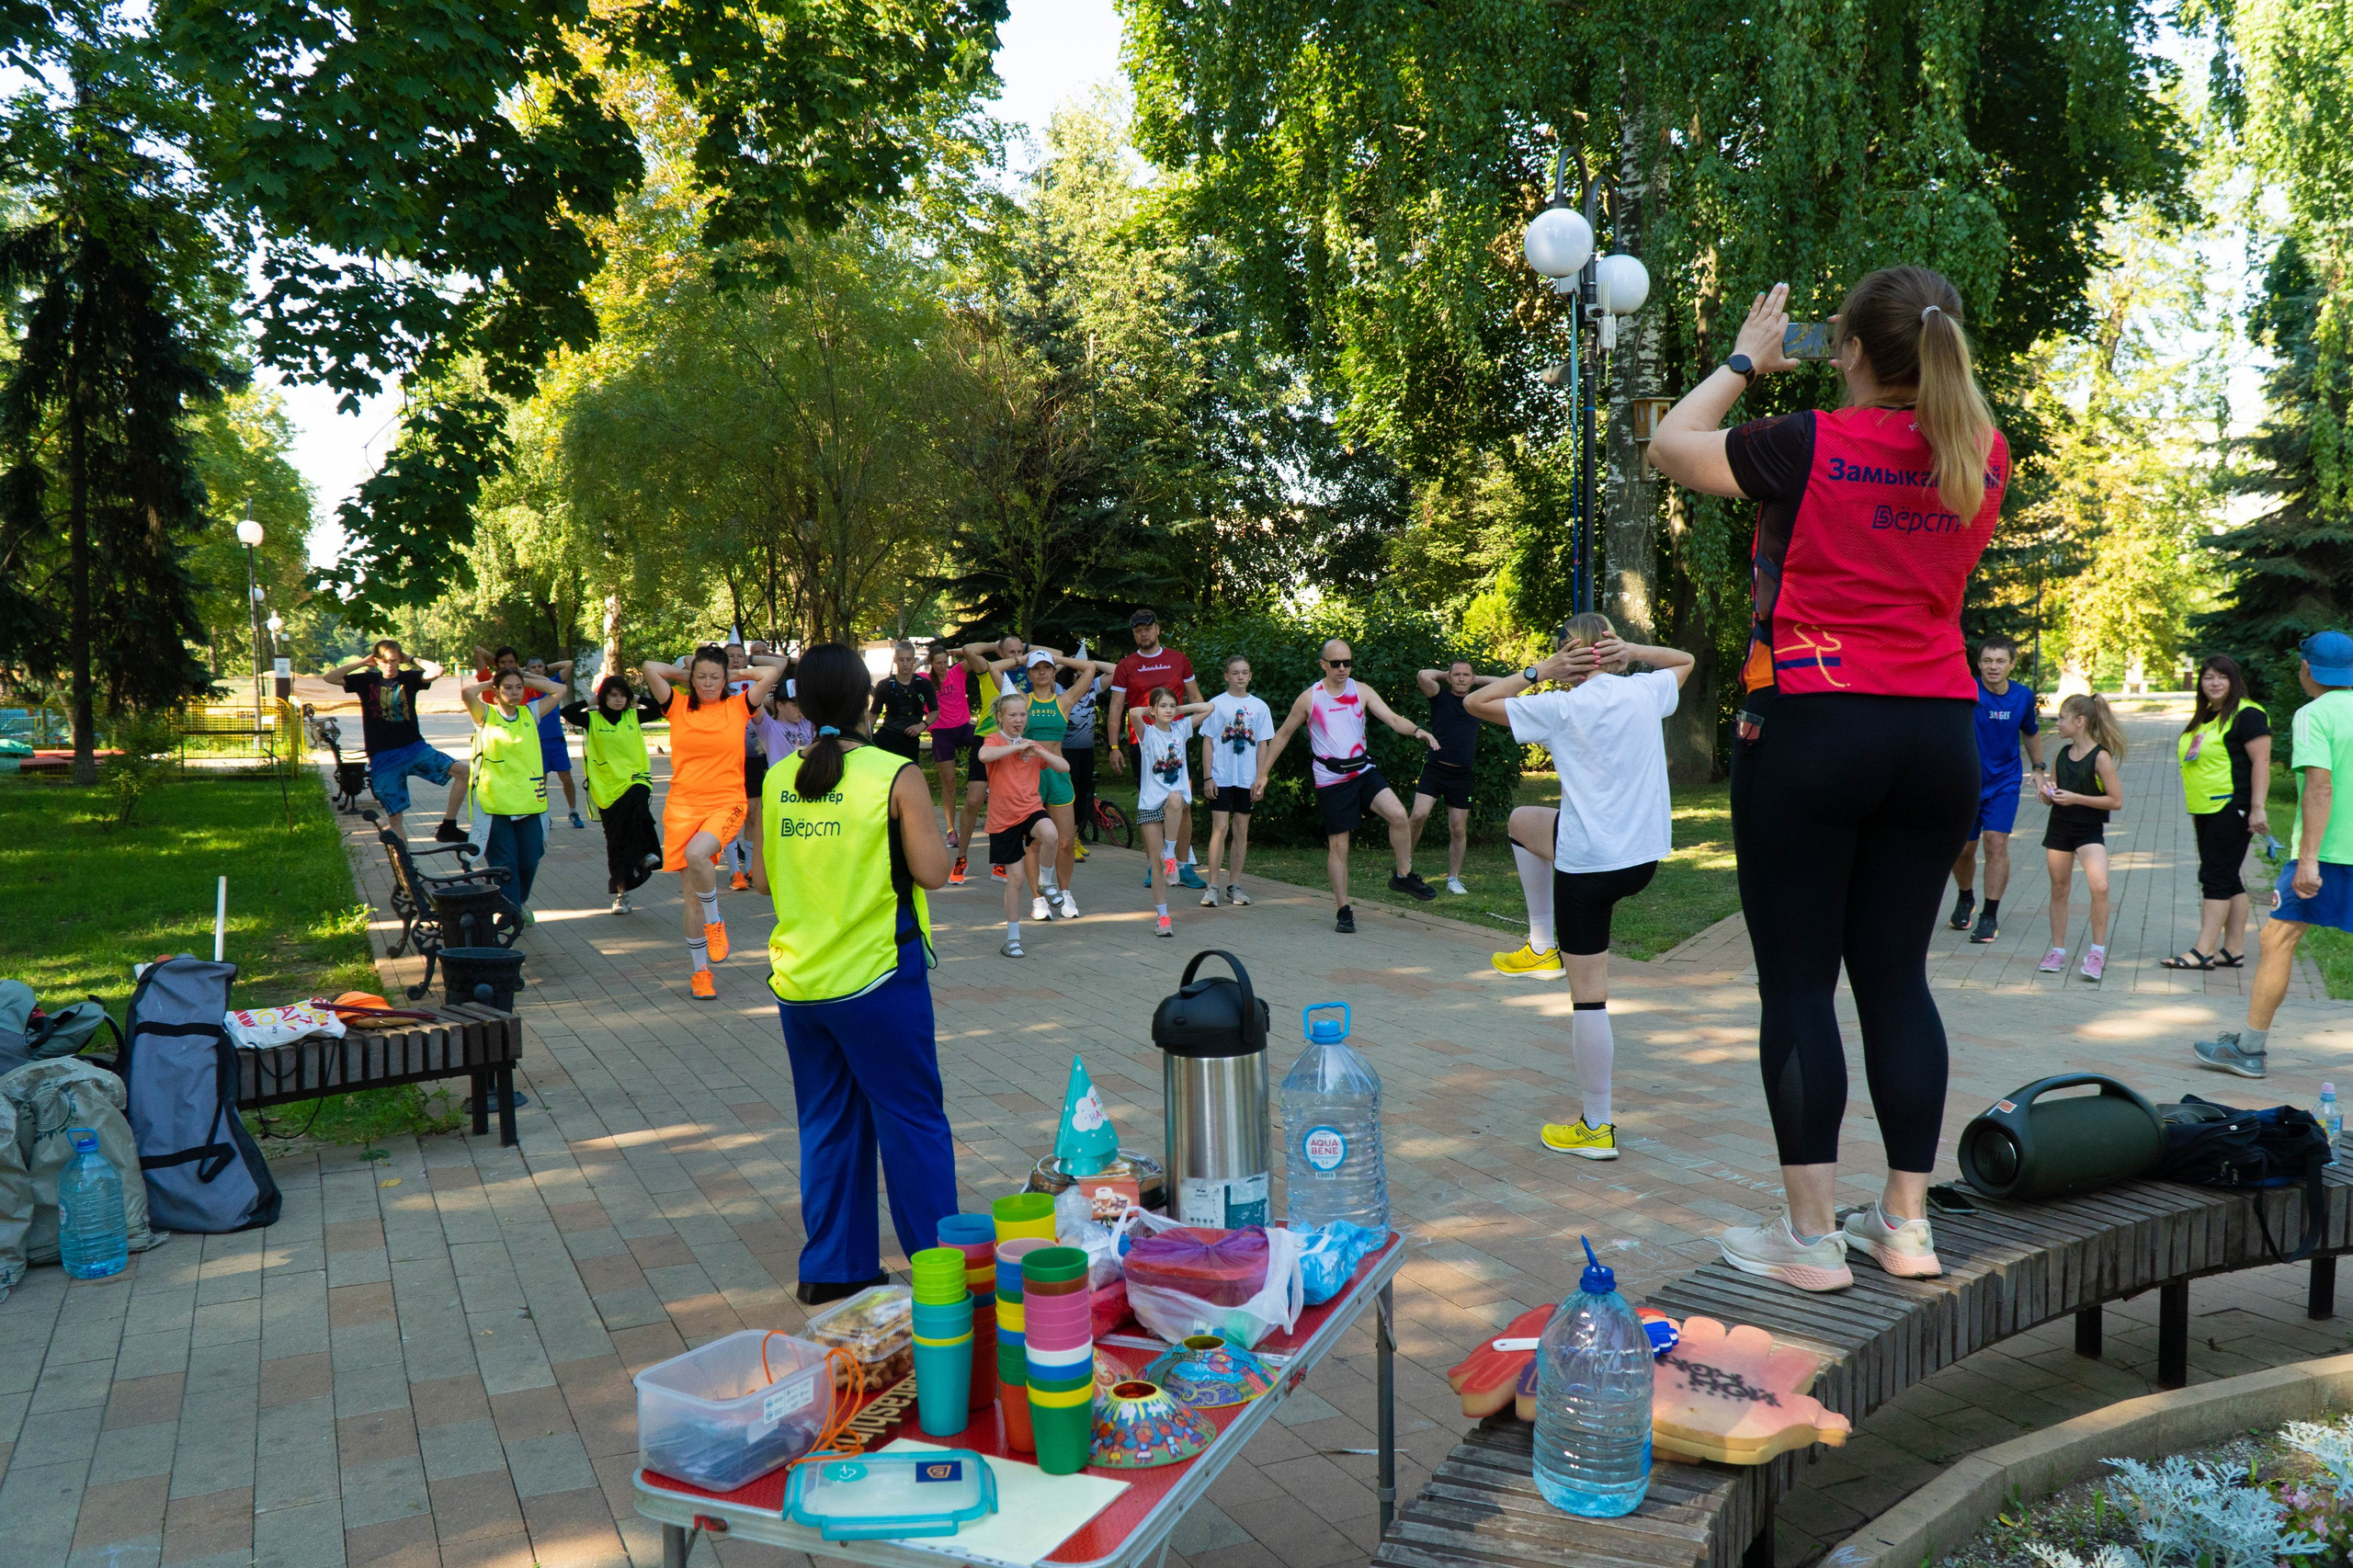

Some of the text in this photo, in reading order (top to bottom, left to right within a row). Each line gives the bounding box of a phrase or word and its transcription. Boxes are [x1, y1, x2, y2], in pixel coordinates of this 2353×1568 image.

[1828, 458, 2000, 489] Замыкаий
[1311, 1139, 1338, 1147] AQUA
[1311, 1147, 1338, 1155] BENE
